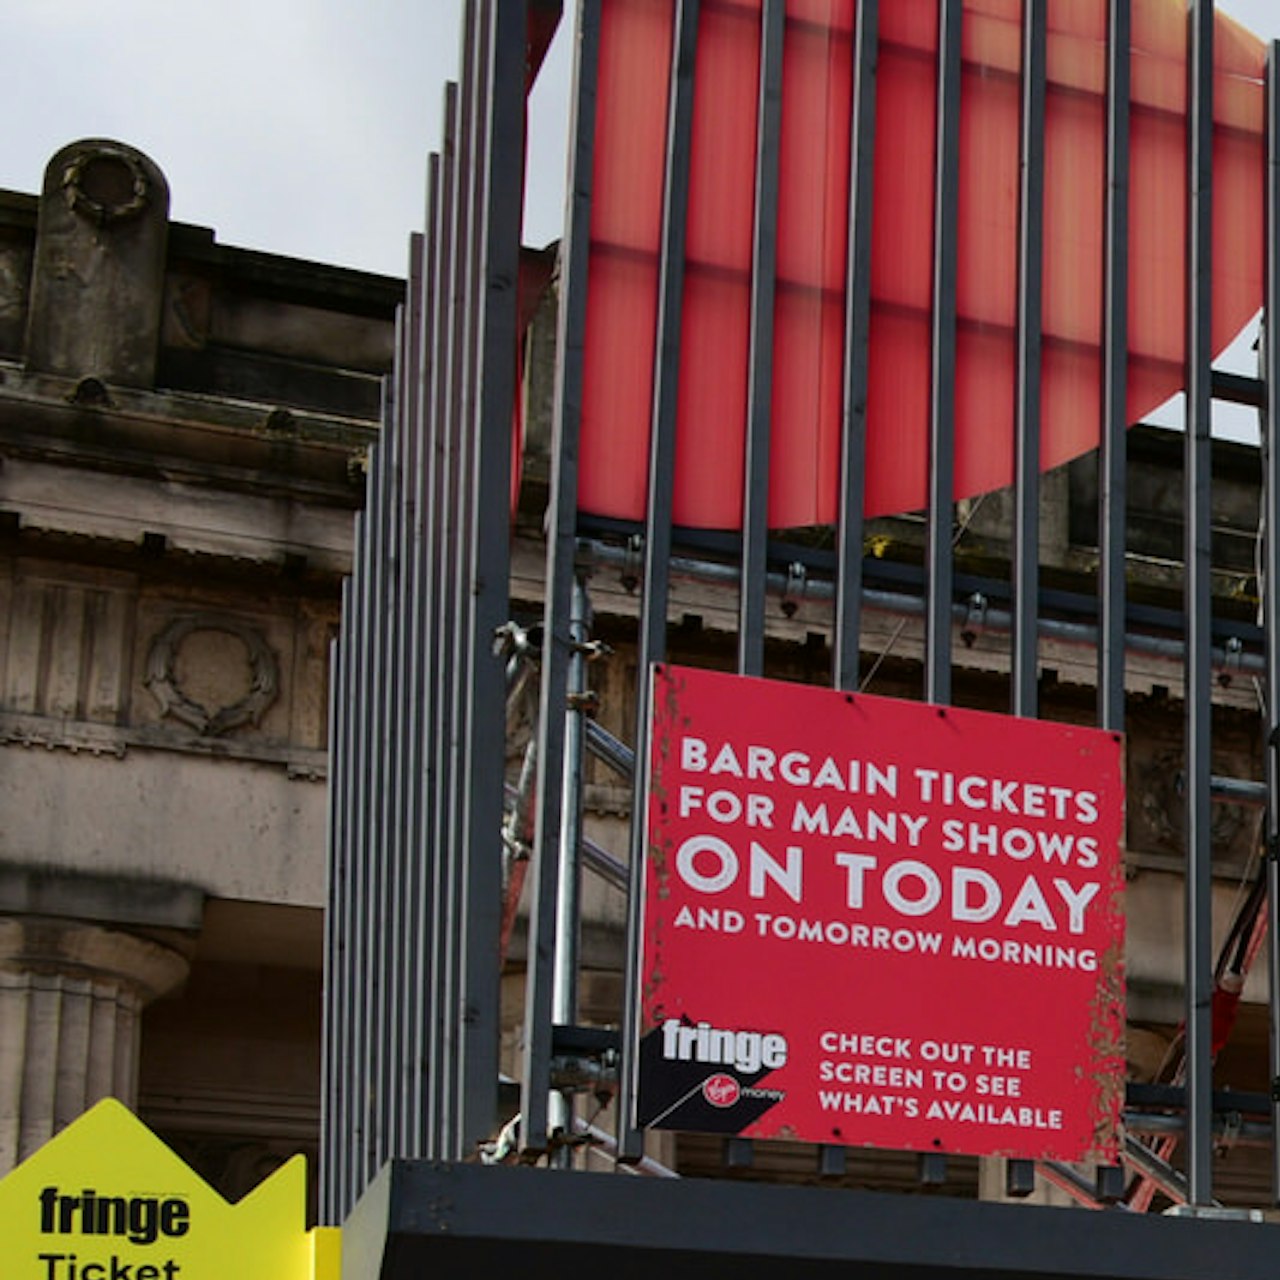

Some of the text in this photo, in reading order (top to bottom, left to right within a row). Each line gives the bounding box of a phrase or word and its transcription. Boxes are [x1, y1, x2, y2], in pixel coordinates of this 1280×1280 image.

[682, 738, 1097, 823] BARGAIN TICKETS
[680, 786, 1098, 867] FOR MANY SHOWS
[676, 835, 1100, 933] ON TODAY
[674, 906, 1096, 971] AND TOMORROW MORNING
[662, 1019, 787, 1073] fringe
[820, 1032, 1030, 1069] CHECK OUT THE
[820, 1061, 1020, 1097] SCREEN TO SEE
[819, 1091, 1061, 1129] WHAT'S AVAILABLE
[39, 1187, 189, 1245] fringe
